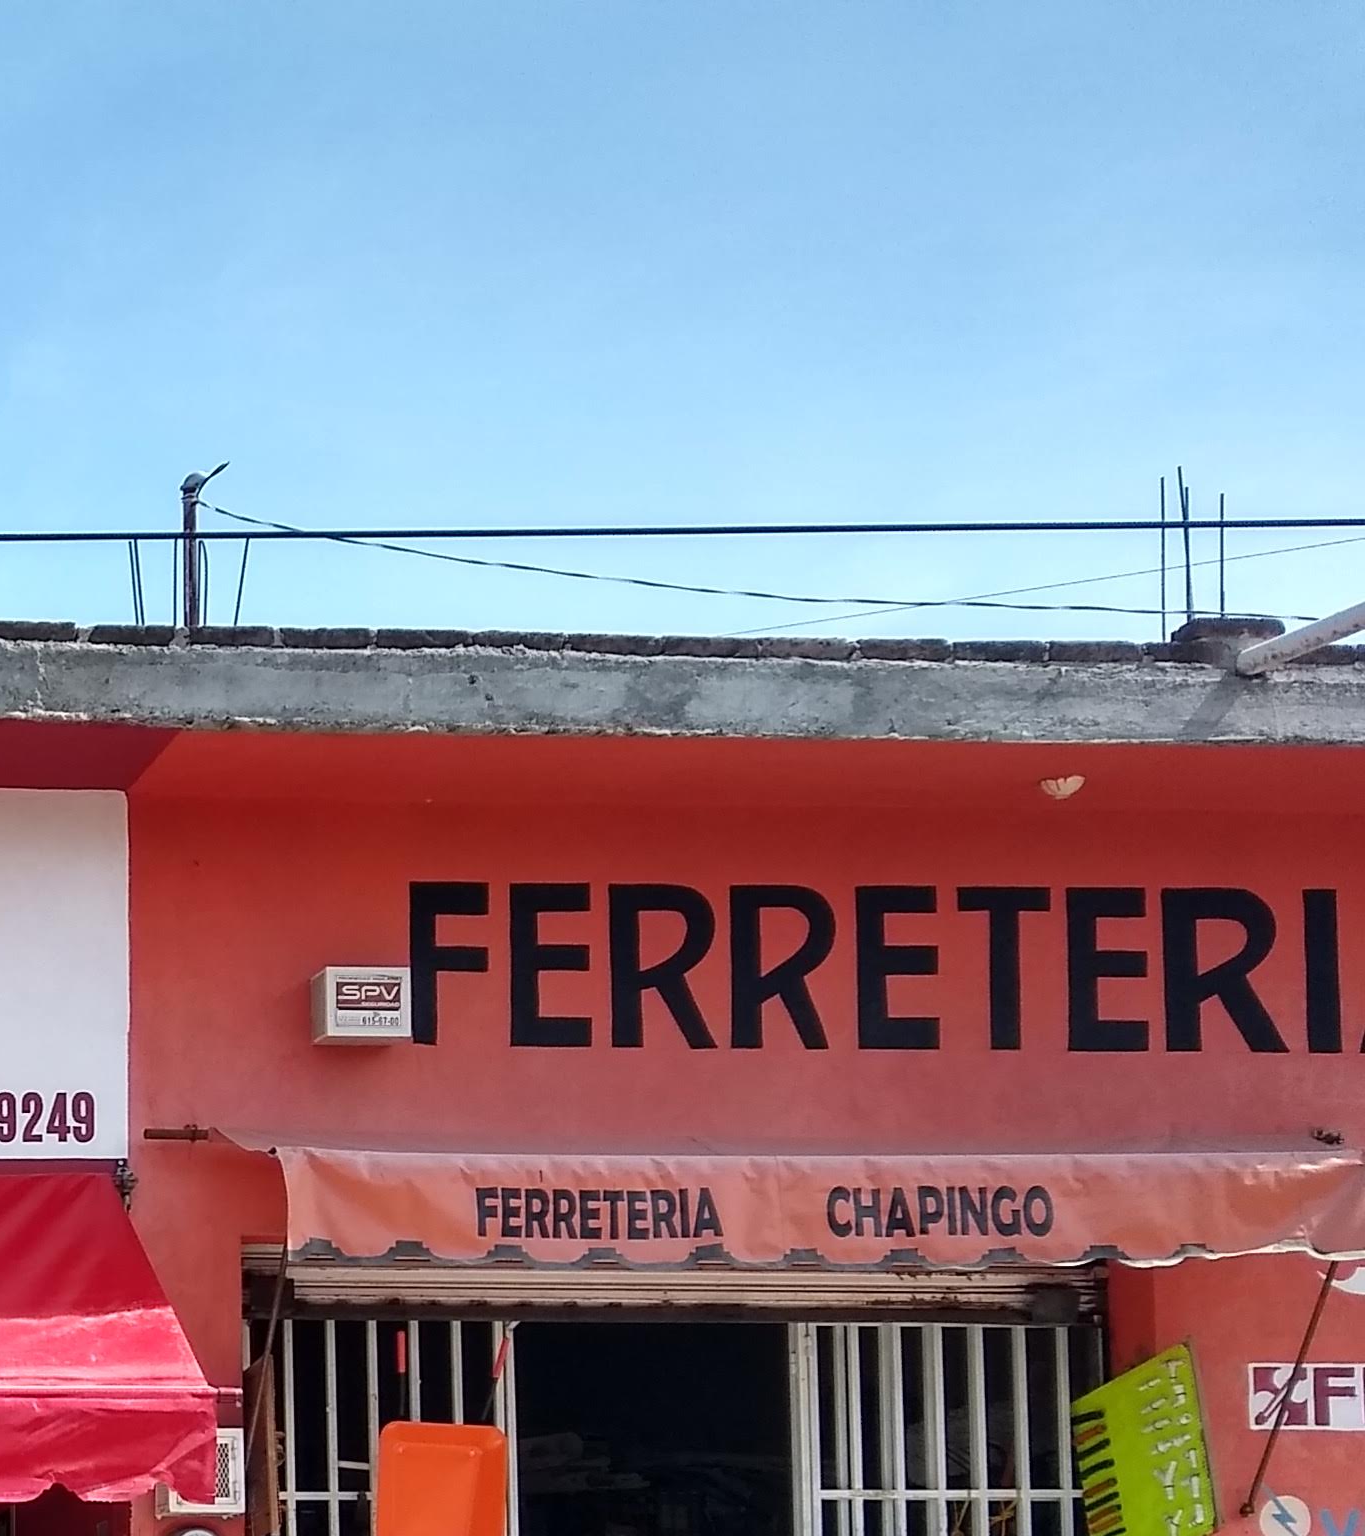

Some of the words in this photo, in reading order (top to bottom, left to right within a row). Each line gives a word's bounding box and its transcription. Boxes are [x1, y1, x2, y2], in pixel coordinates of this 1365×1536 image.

[338, 985, 399, 1000] SPV
[409, 881, 1365, 1053] FERRETERI
[475, 1186, 725, 1240] FERRETERIA
[826, 1185, 1055, 1238] CHAPINGO
[1313, 1366, 1365, 1426] F
